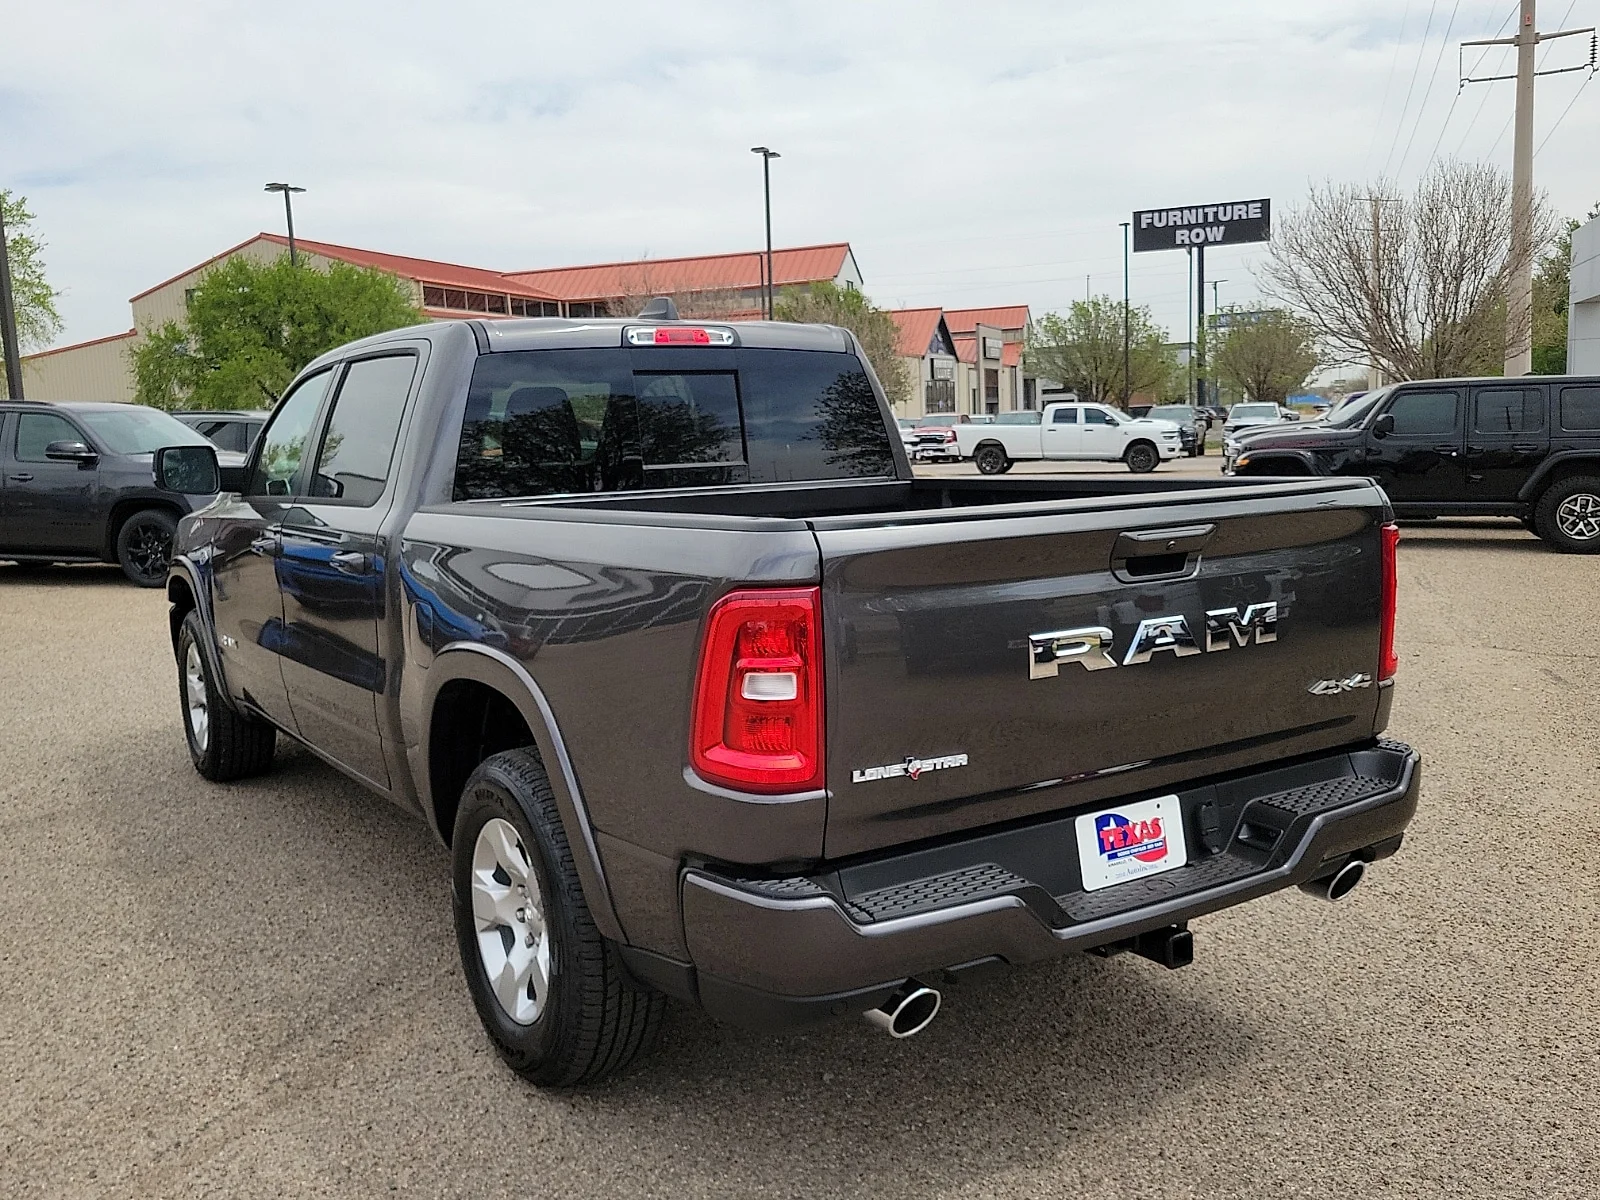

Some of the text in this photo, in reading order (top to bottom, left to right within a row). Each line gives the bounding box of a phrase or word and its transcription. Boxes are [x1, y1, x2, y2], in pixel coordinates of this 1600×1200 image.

[1140, 203, 1262, 228] FURNITURE
[1175, 225, 1226, 245] ROW
[1028, 601, 1278, 680] RAM
[1100, 817, 1162, 850] TEXAS
